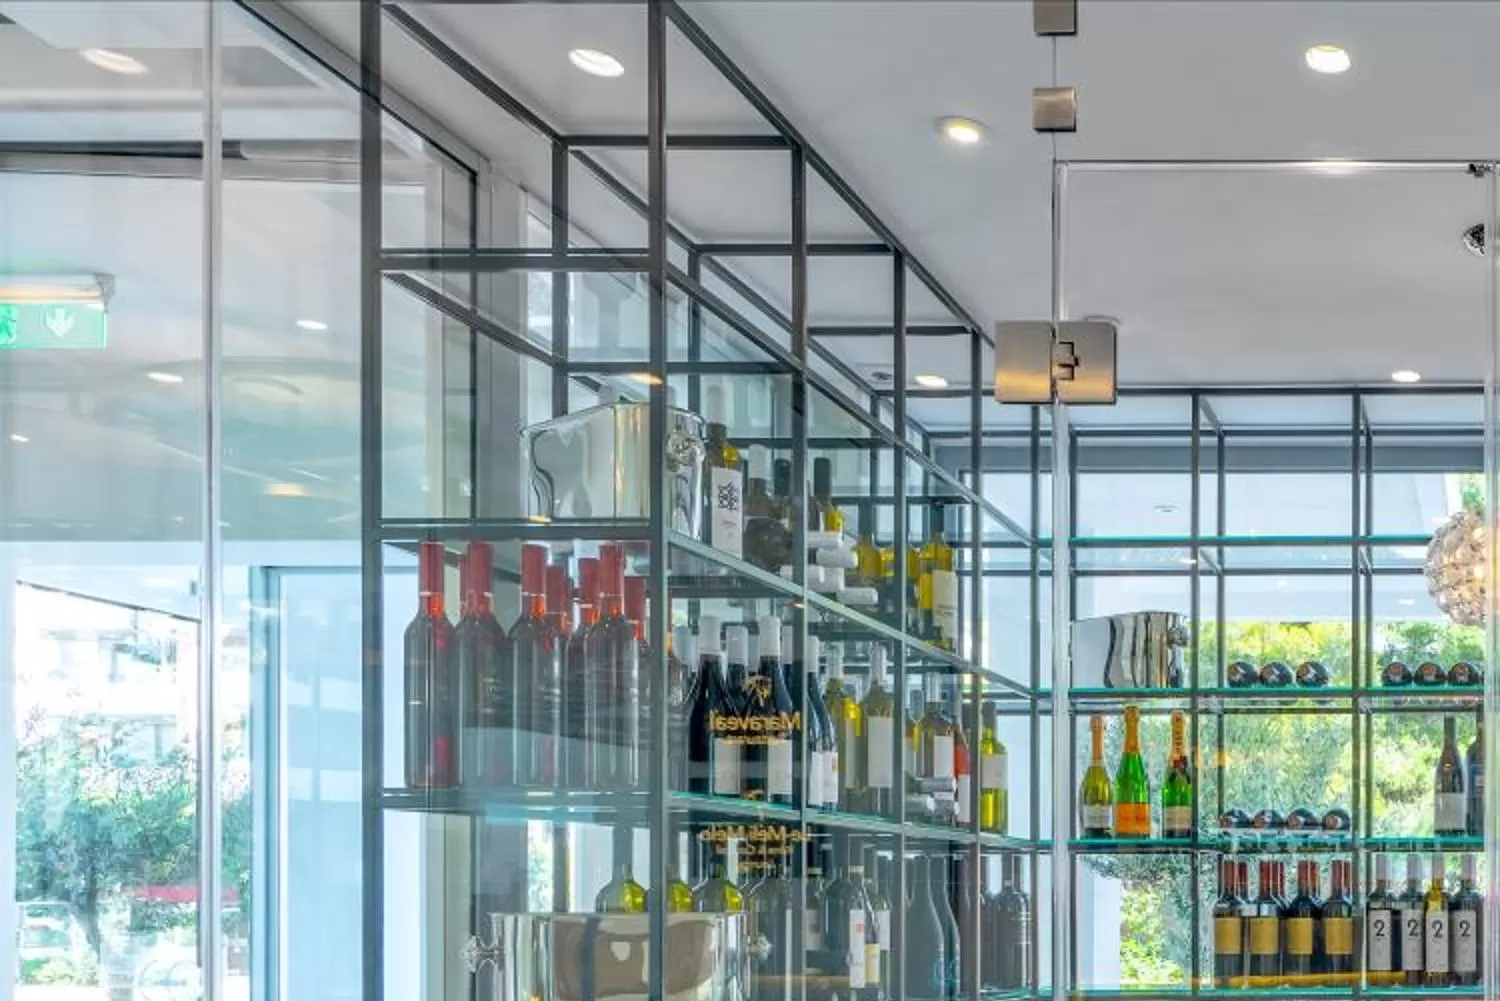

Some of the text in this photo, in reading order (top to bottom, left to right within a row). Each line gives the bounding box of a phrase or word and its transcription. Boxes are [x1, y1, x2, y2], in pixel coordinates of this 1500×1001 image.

[1373, 919, 1385, 937] 2
[1407, 919, 1420, 937] 2
[1431, 919, 1443, 938] 2
[1459, 919, 1471, 937] 2
